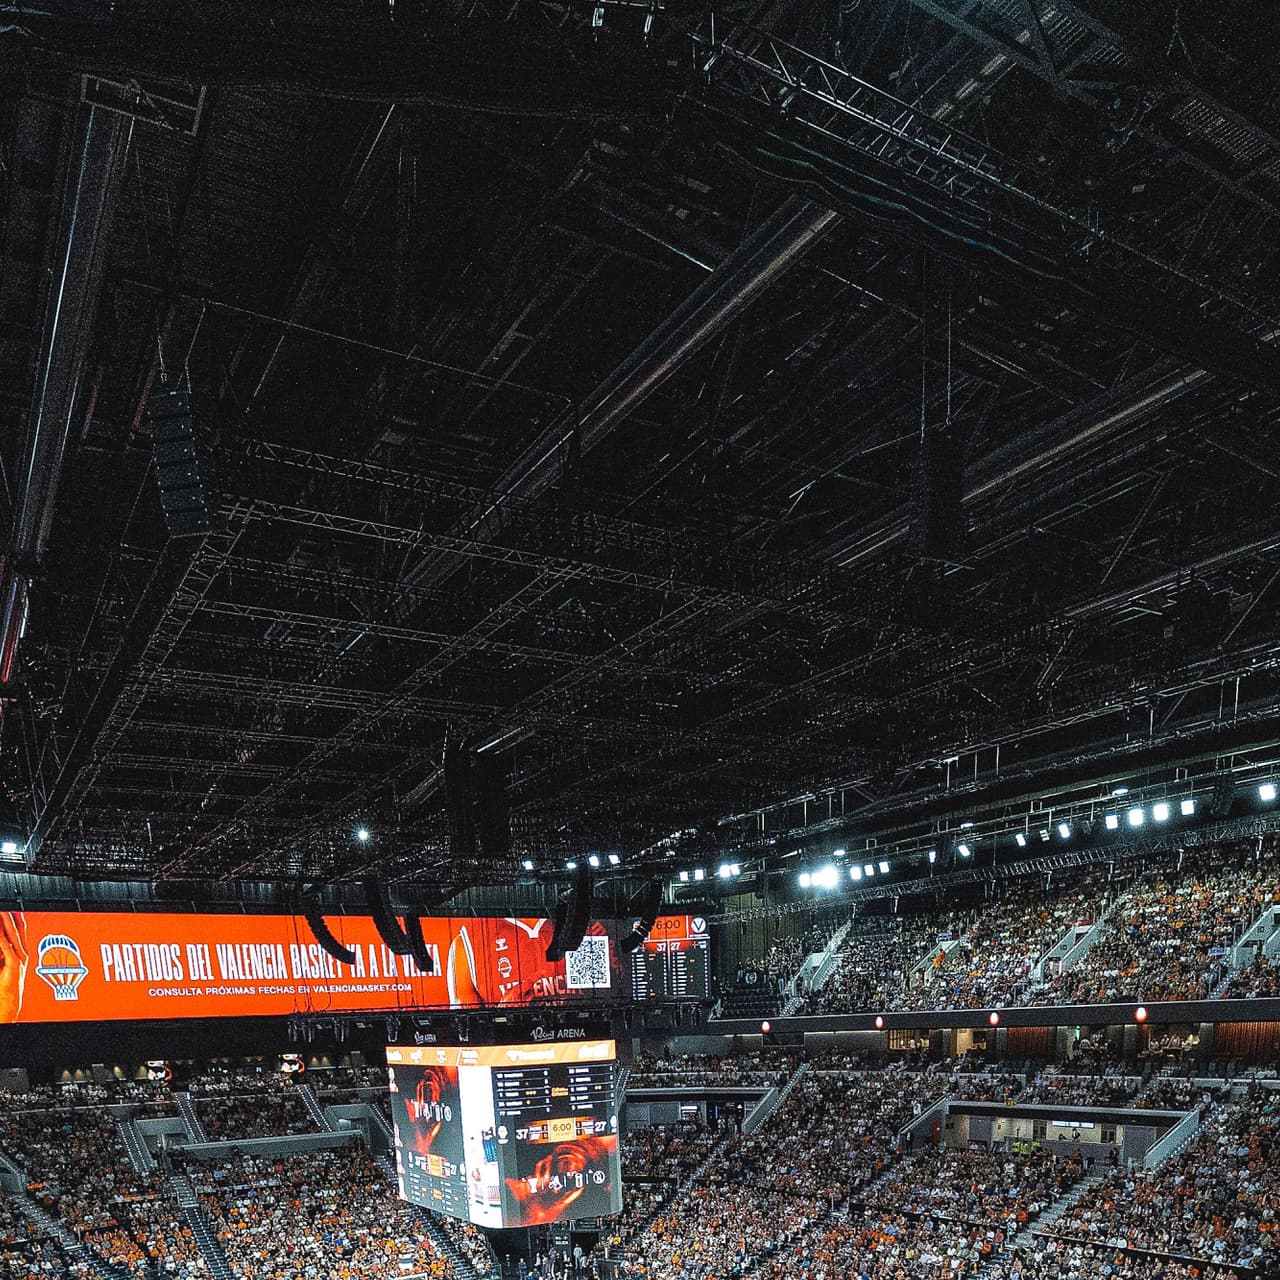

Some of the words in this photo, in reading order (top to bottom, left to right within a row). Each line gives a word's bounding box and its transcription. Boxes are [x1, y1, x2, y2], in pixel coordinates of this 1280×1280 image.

[656, 919, 681, 930] 6:00
[670, 942, 681, 951] 27
[100, 943, 184, 982] PARTIDOS
[186, 943, 214, 981] DEL
[216, 943, 289, 980] VALENCIA
[369, 943, 379, 978] A
[148, 987, 203, 997] CONSULTA
[205, 985, 256, 996] PRÓXIMAS
[258, 985, 296, 994] FECHAS
[298, 984, 310, 994] EN
[313, 983, 412, 993] VALENCIABASKET.COM
[556, 1028, 586, 1039] ARENA
[594, 1121, 607, 1132] 27
[516, 1129, 529, 1140] 37
